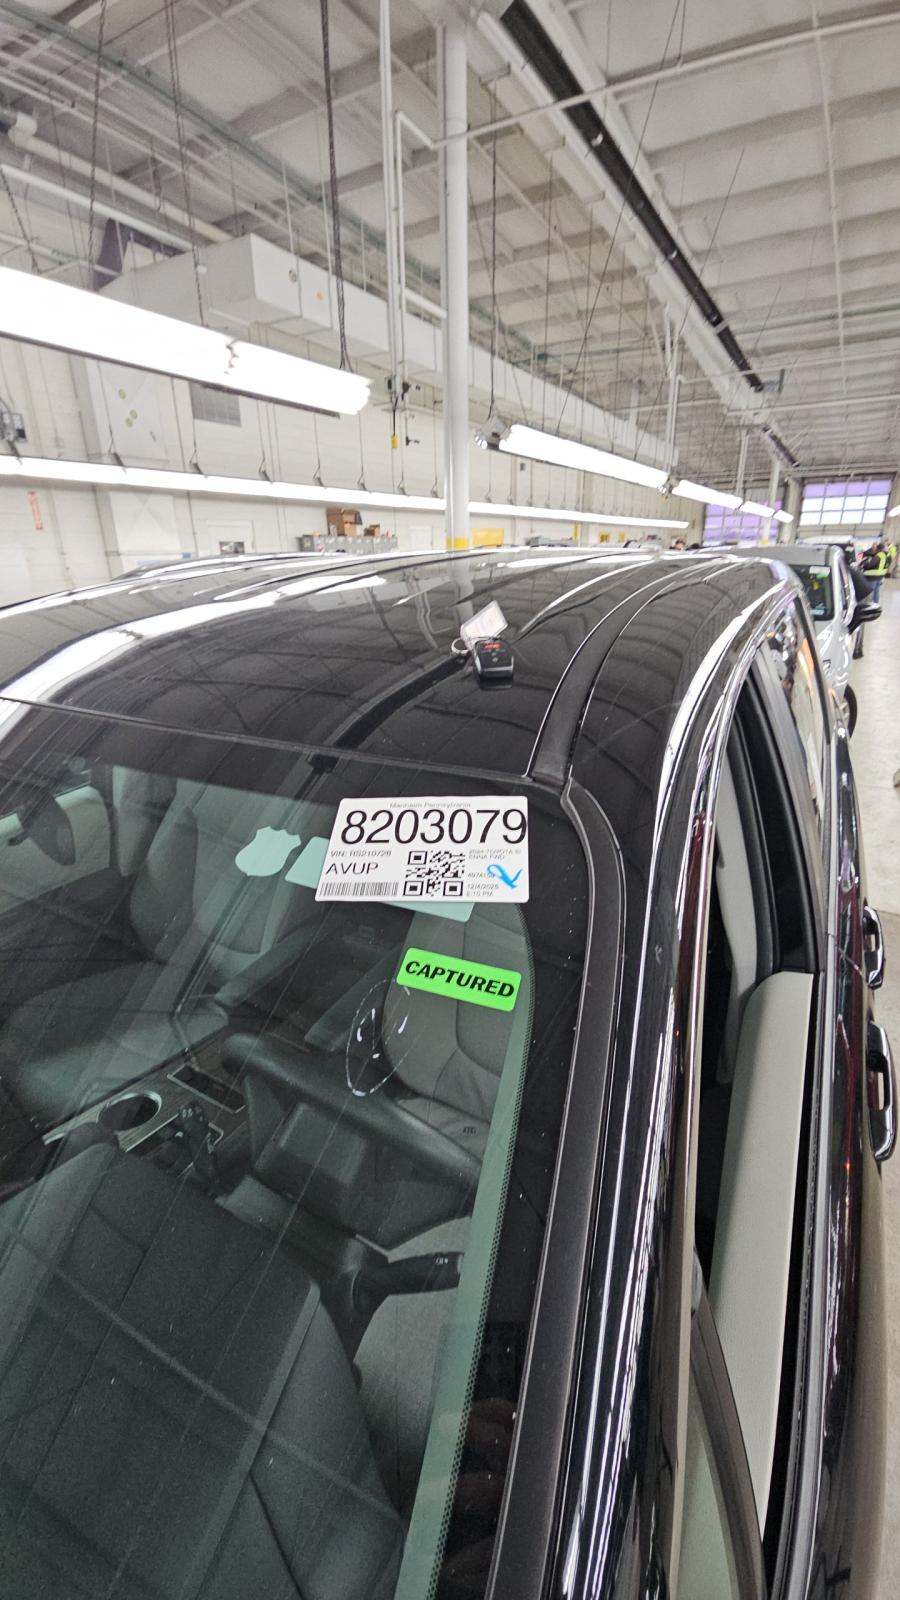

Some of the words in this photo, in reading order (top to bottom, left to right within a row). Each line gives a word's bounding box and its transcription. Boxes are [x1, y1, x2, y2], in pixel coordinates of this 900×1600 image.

[340, 808, 528, 845] 8203079
[326, 862, 379, 875] AVUP
[405, 961, 515, 997] CAPTURED
